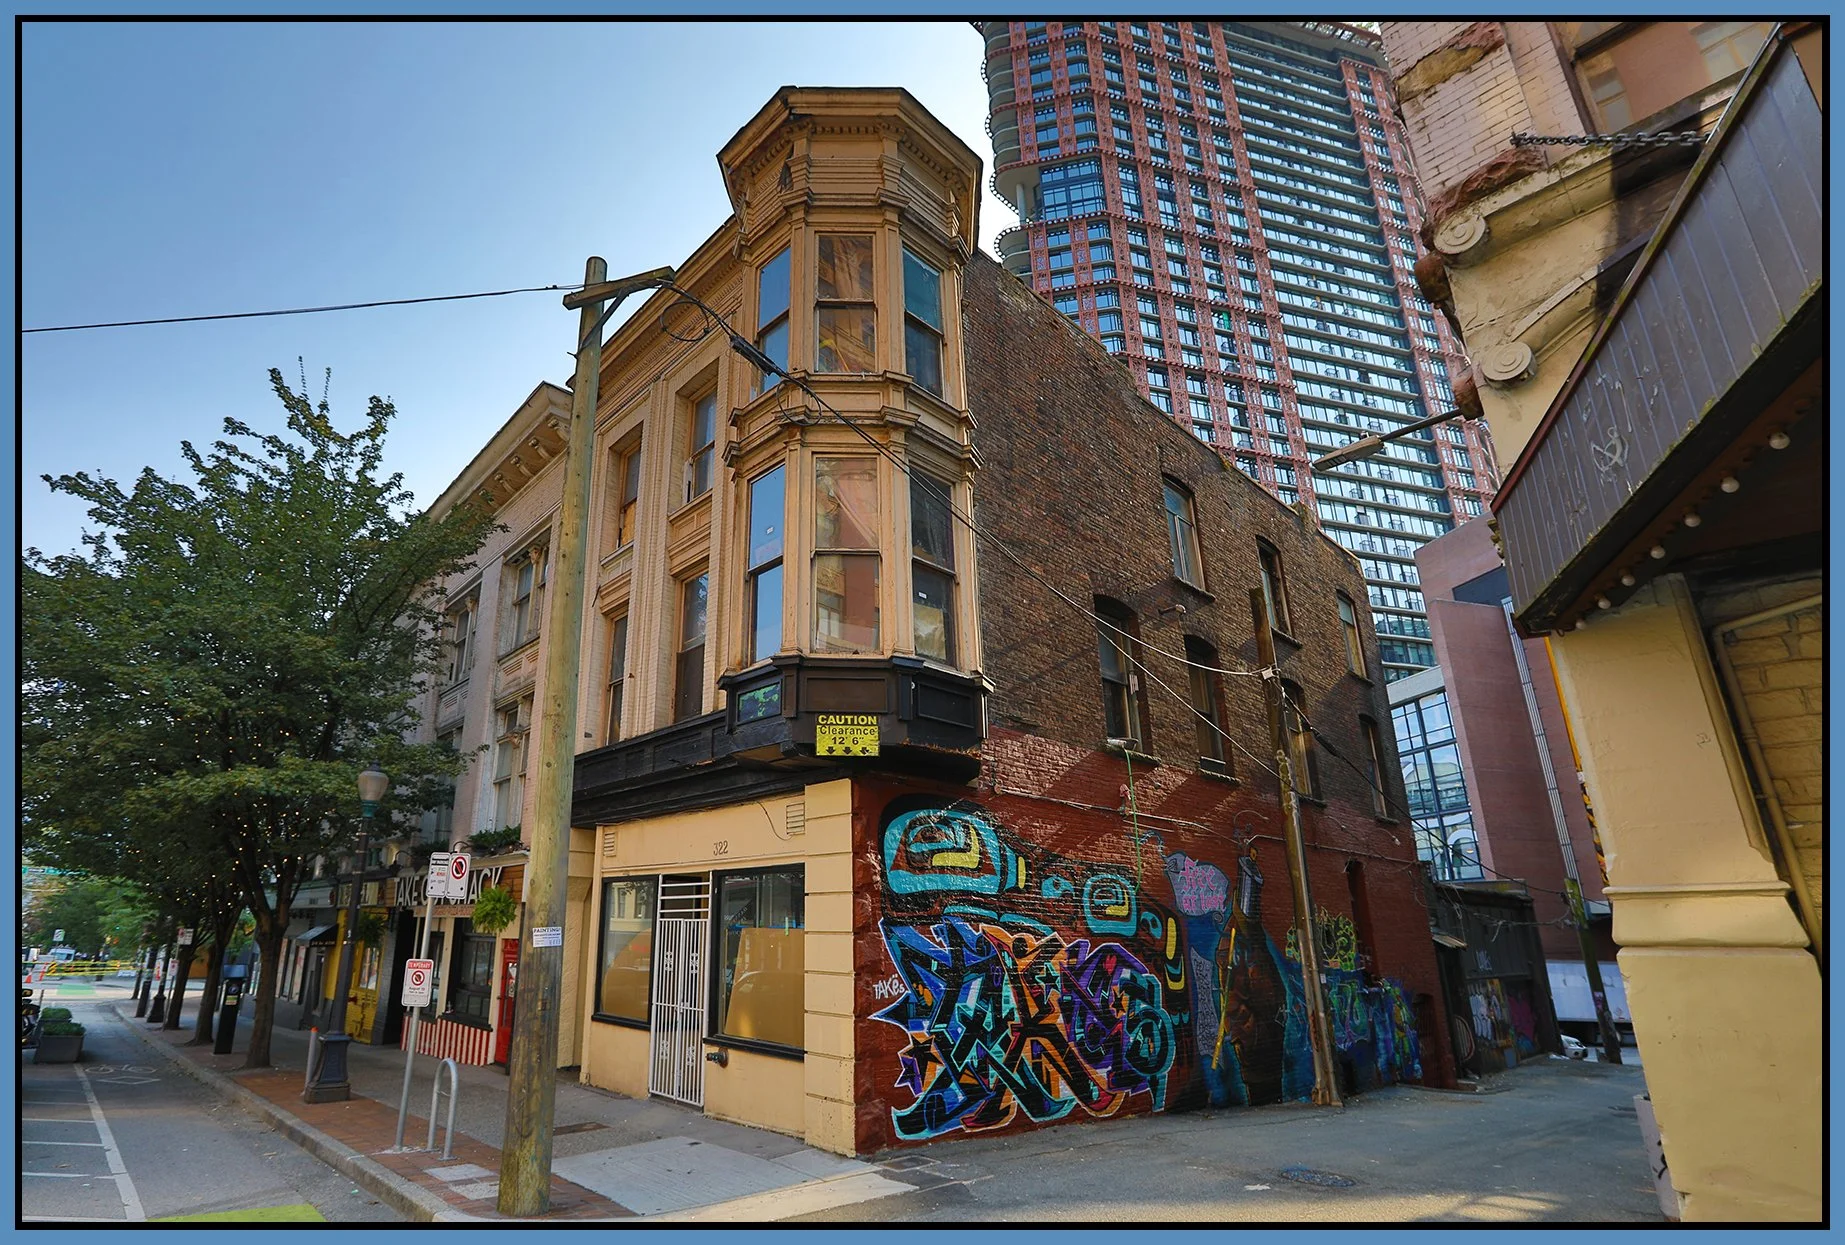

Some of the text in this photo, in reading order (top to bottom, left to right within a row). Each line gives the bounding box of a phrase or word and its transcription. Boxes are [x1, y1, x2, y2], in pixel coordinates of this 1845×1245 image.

[818, 714, 877, 725] CAUTION
[820, 725, 875, 735] Clearance
[713, 840, 729, 856] 322
[393, 875, 421, 907] TAKE
